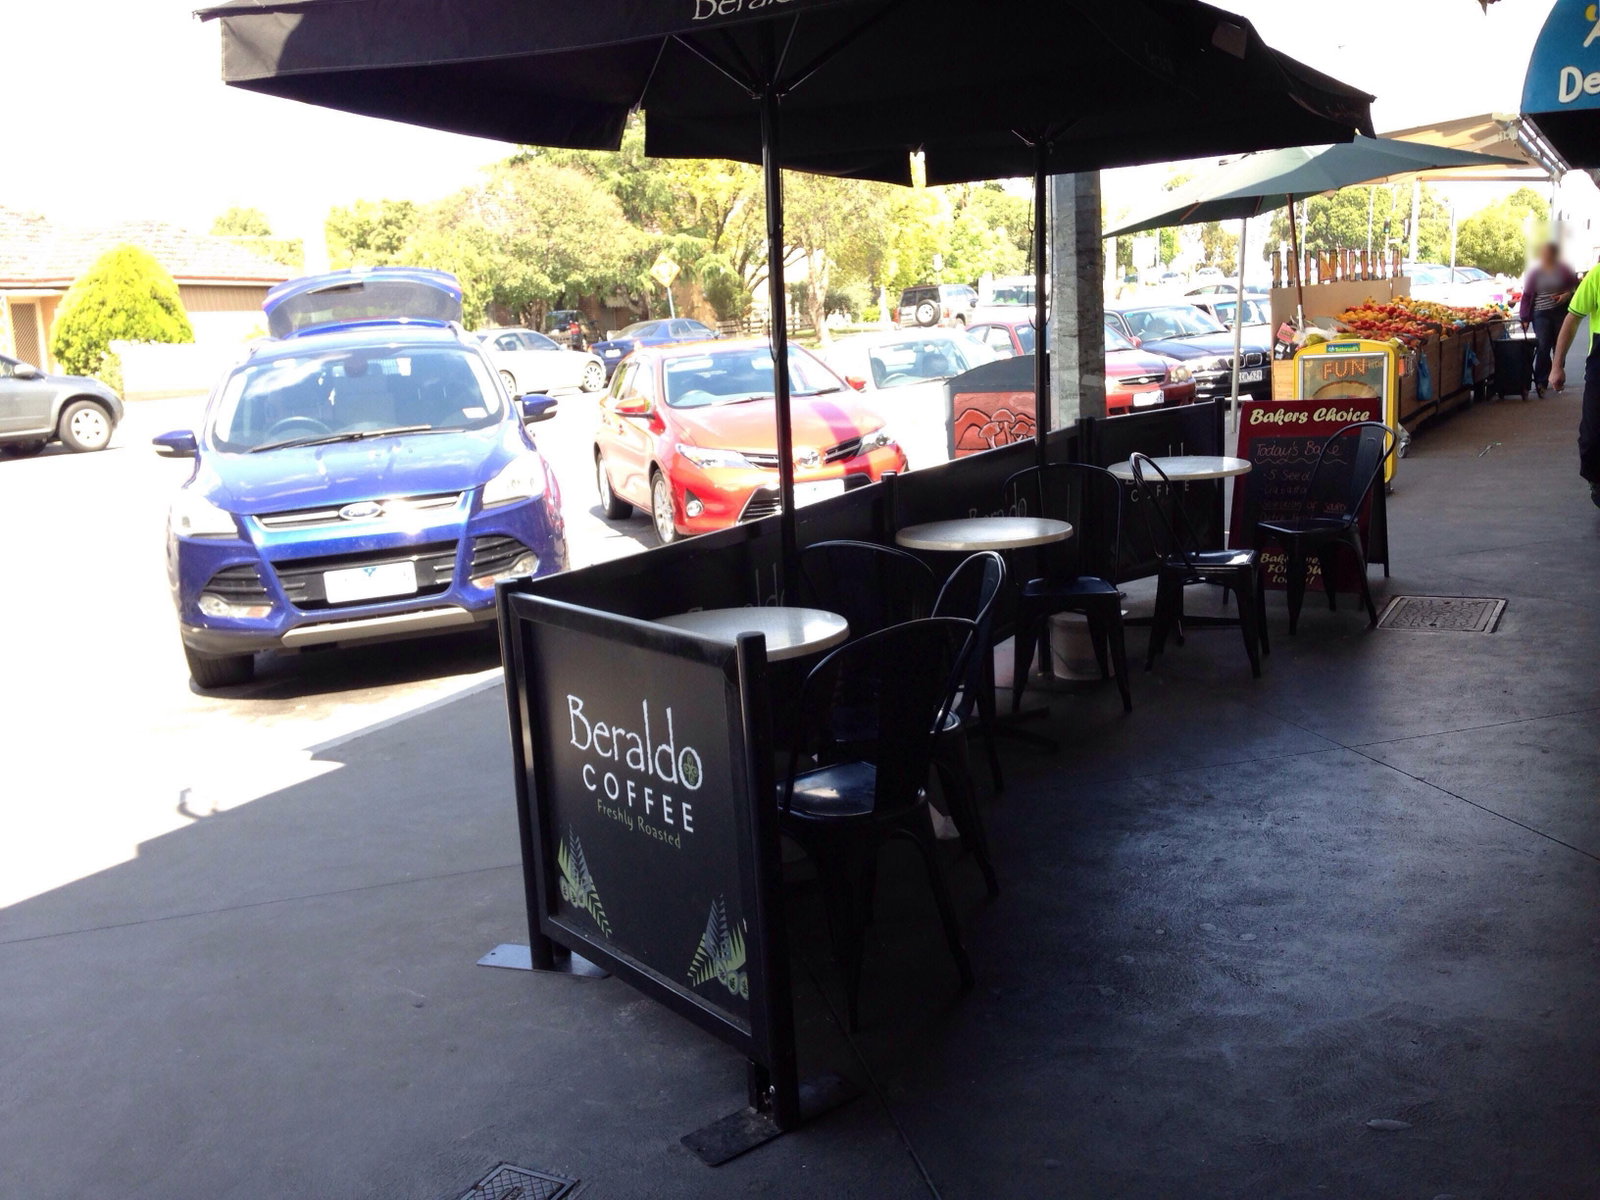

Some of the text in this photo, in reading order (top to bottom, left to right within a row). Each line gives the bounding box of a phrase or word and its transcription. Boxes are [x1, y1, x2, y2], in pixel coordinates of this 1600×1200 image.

[1323, 358, 1366, 380] FUN
[1249, 406, 1371, 426] Bakers Choice
[1256, 439, 1344, 460] Today's Bae
[566, 694, 704, 791] Beraldo
[582, 764, 695, 834] COFFEE
[596, 798, 682, 849] Freshly Roasted
